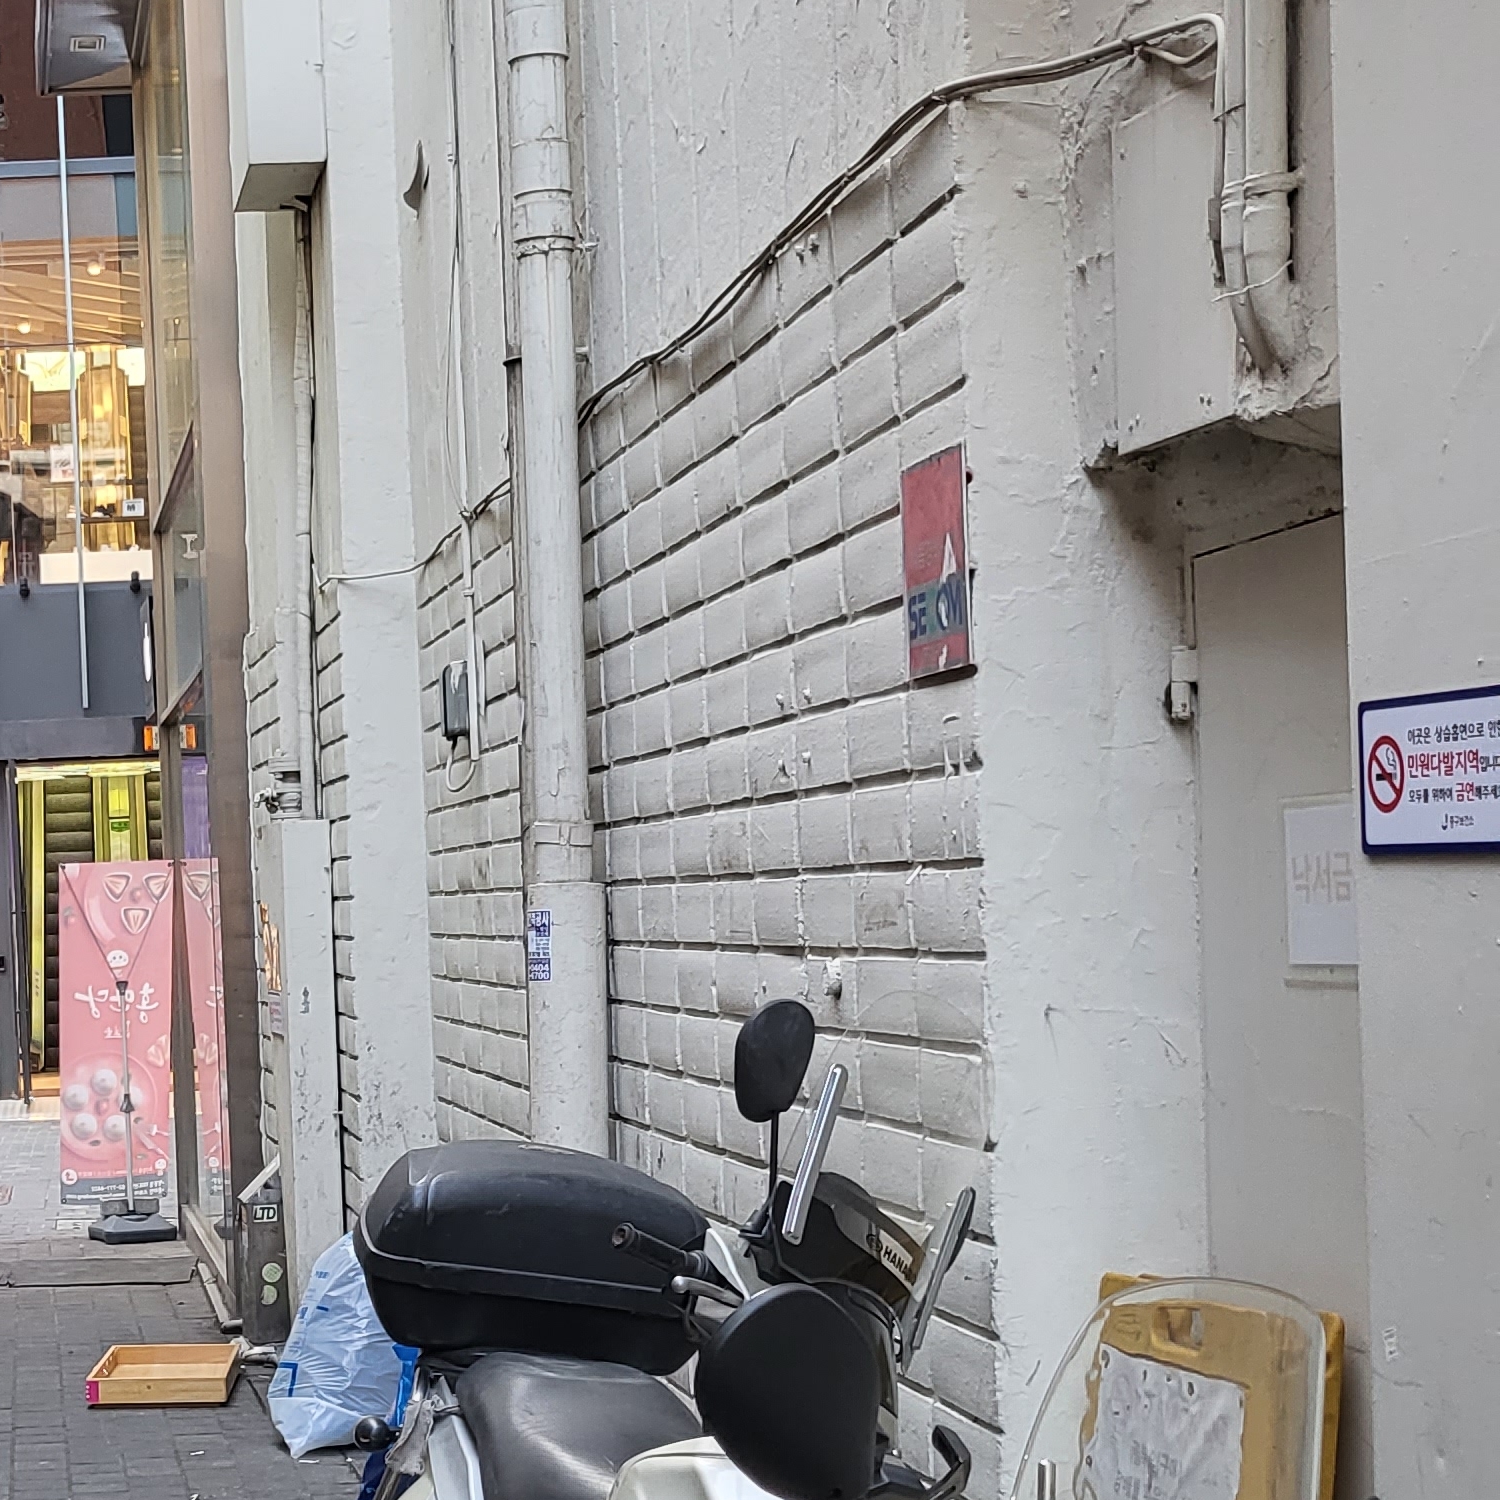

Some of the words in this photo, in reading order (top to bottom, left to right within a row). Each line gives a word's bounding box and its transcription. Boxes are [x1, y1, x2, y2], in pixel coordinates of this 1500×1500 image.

[908, 578, 964, 641] SEOM
[1407, 726, 1432, 745] 이곳은
[1434, 722, 1485, 743] 상습흡연으로
[1455, 781, 1500, 803] 금연해주세
[254, 1206, 277, 1221] LTD
